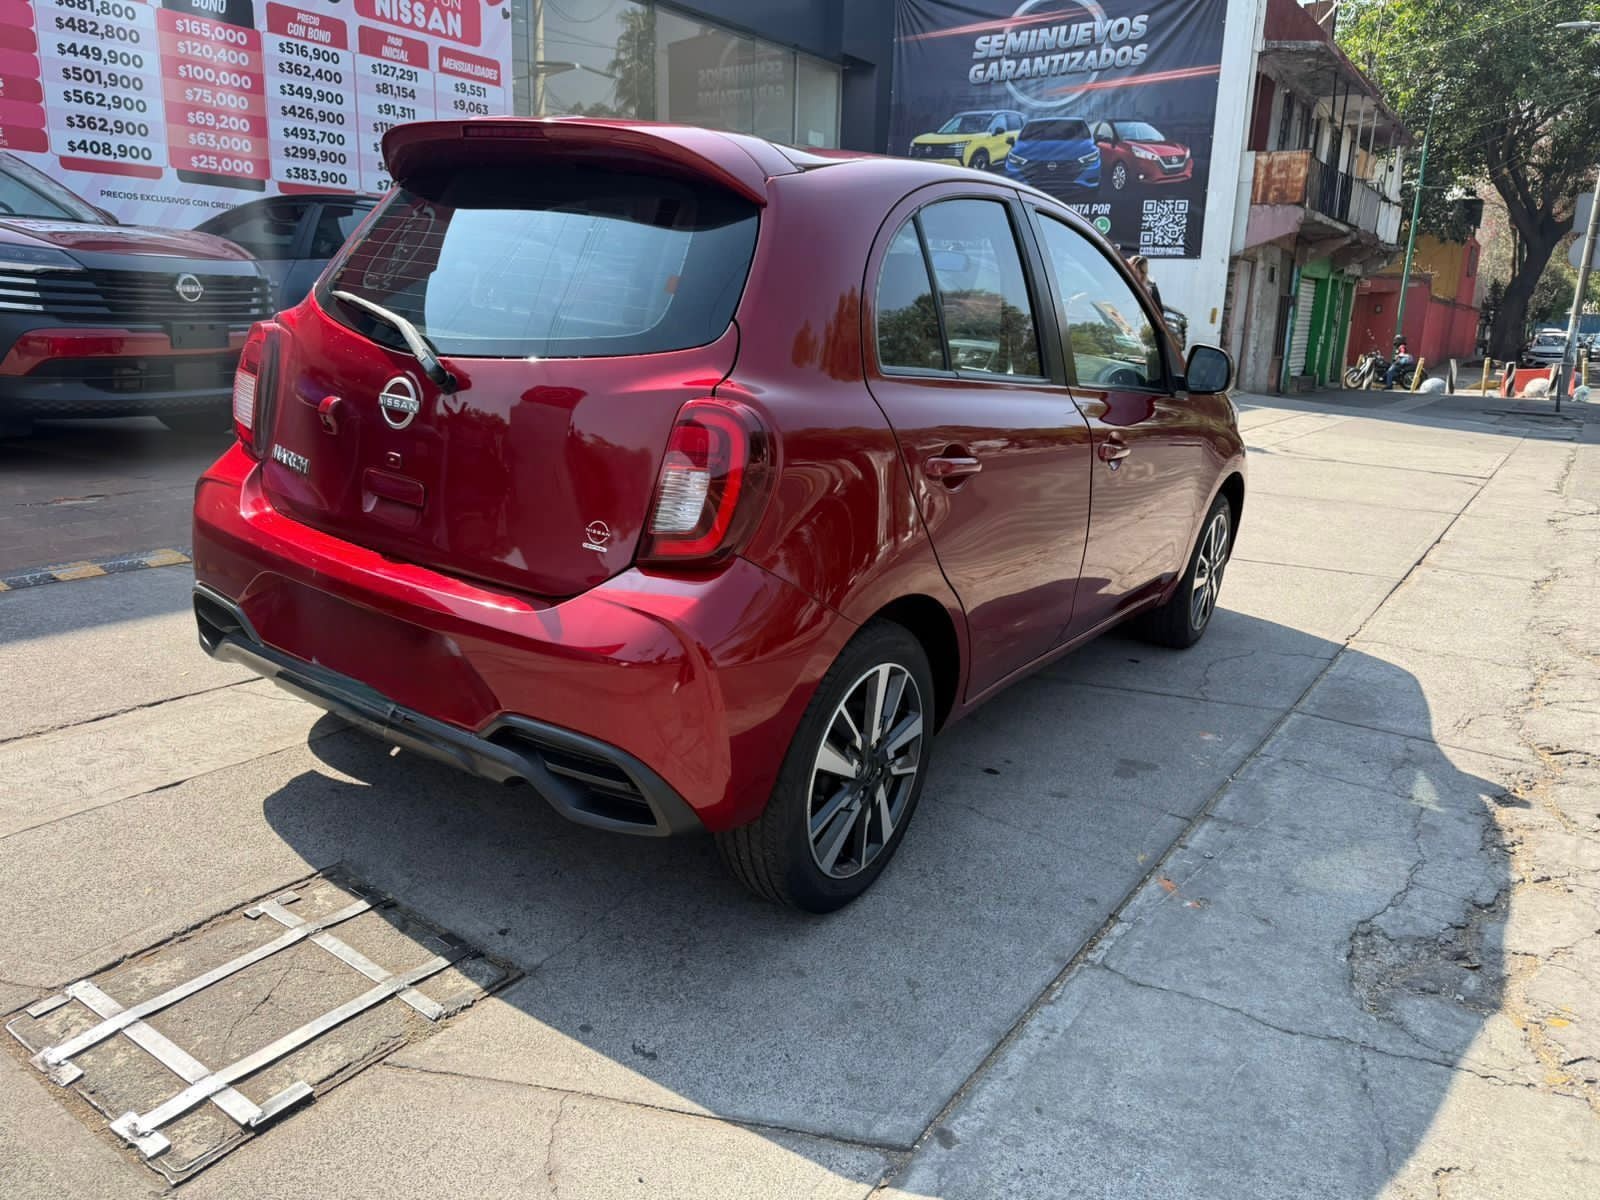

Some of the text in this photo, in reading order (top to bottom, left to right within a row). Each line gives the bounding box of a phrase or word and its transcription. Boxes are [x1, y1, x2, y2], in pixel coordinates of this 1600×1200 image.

[297, 12, 320, 26] PRECIO
[374, 0, 462, 39] NISSAN
[55, 16, 140, 44] $482,800
[175, 18, 247, 45] $165,000
[287, 22, 332, 44] CON BONO
[972, 14, 1149, 59] SEMINUEVOS
[57, 42, 143, 69] $449,900
[177, 40, 249, 66] $120,400
[278, 41, 340, 64] $516,900
[382, 45, 409, 62] INICIAL
[278, 61, 343, 85] $362,400
[371, 63, 418, 83] $127,291
[442, 56, 498, 81] MENSUALIDADES
[969, 43, 1149, 85] GARANTIZADOS
[62, 66, 143, 91] $501,900
[178, 64, 252, 89] $100,000
[185, 87, 249, 109] $75,000
[279, 83, 344, 105] $349,900
[375, 82, 416, 101] $81,154
[454, 82, 487, 98] $9,551
[63, 89, 147, 113] $562,900
[377, 103, 416, 120] $91,311
[453, 99, 489, 115] $9,063
[66, 114, 149, 137] $362,900
[187, 111, 250, 132] $69,200
[281, 105, 345, 126] $426,900
[188, 132, 252, 152] $63,000
[283, 126, 345, 146] $493,700
[67, 139, 152, 160] $408,900
[284, 146, 347, 165] $299,900
[191, 154, 254, 174] $25,000
[286, 167, 348, 185] $383,900
[100, 189, 139, 201] PRECIOS
[140, 193, 191, 206] EXCLUSIVOS
[192, 199, 210, 208] CON
[1090, 203, 1111, 215] POR
